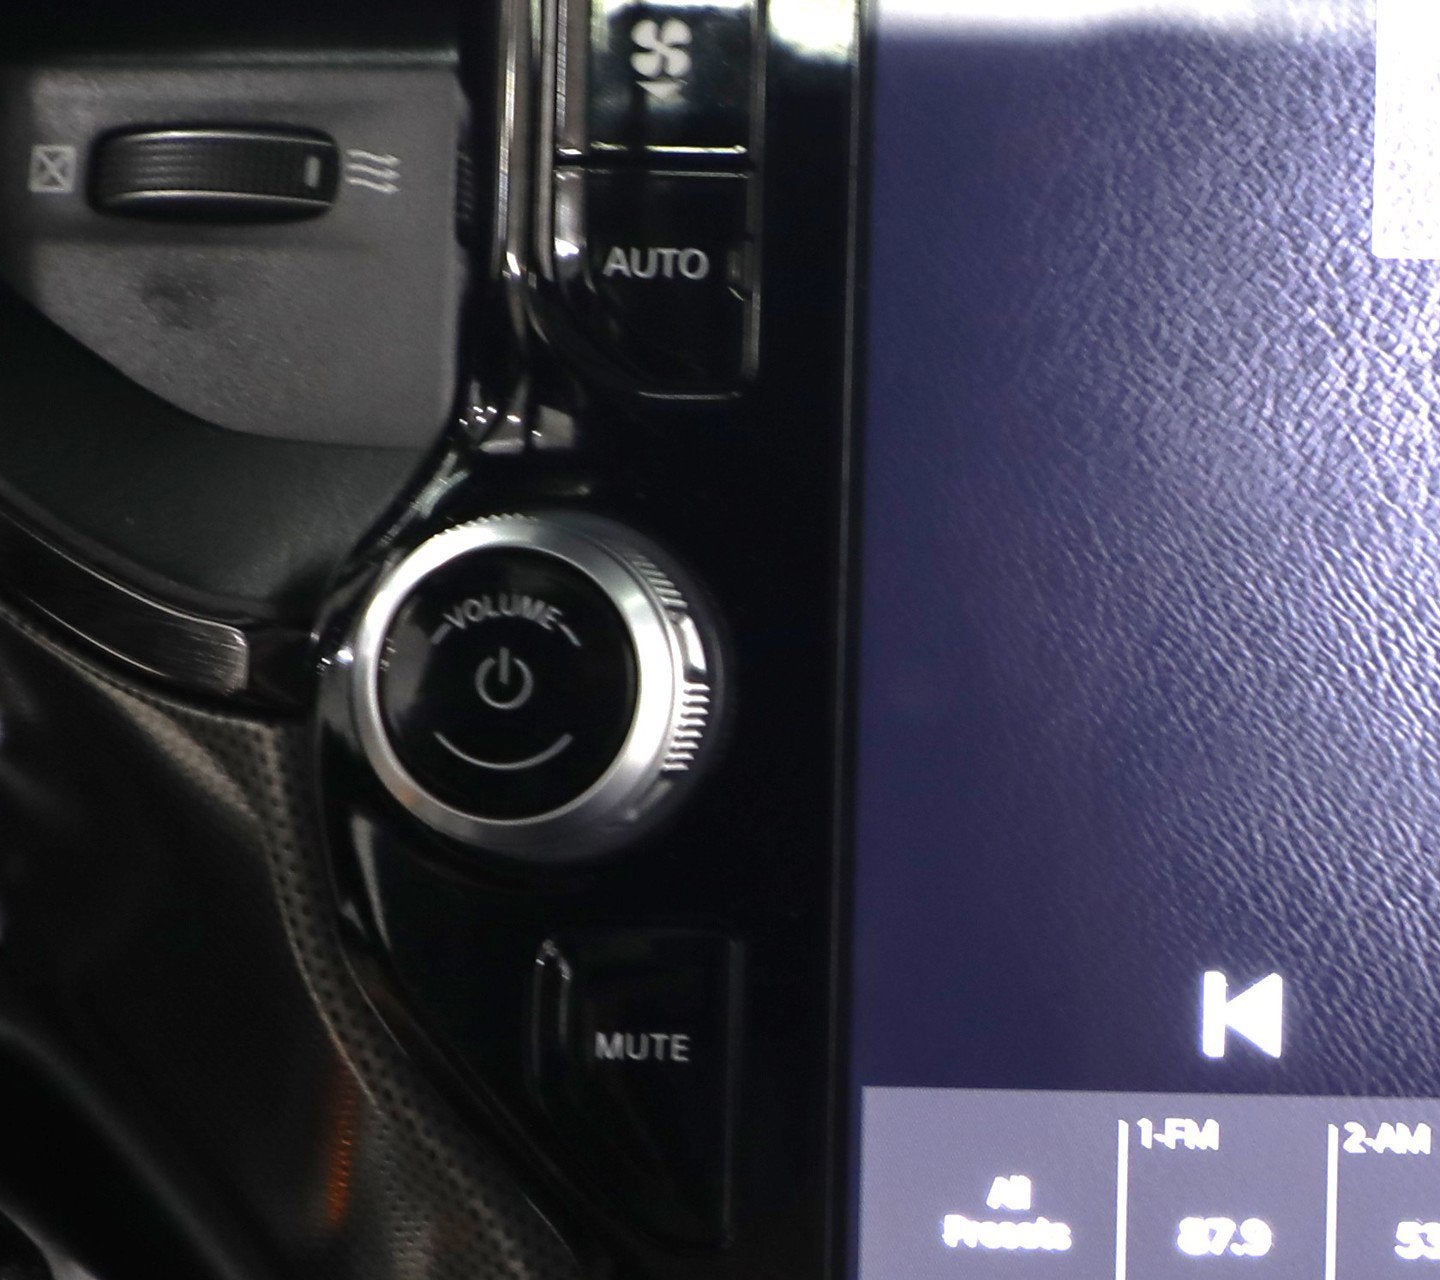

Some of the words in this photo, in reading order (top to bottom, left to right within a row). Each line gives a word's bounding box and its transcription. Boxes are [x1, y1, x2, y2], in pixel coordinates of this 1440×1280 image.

[603, 247, 708, 280] AUTO
[444, 595, 563, 631] VOLUME
[595, 1032, 690, 1063] MUTE
[1137, 1118, 1219, 1151] 1-FM
[1343, 1122, 1431, 1155] 2-AM
[1176, 1217, 1273, 1257] 87.9
